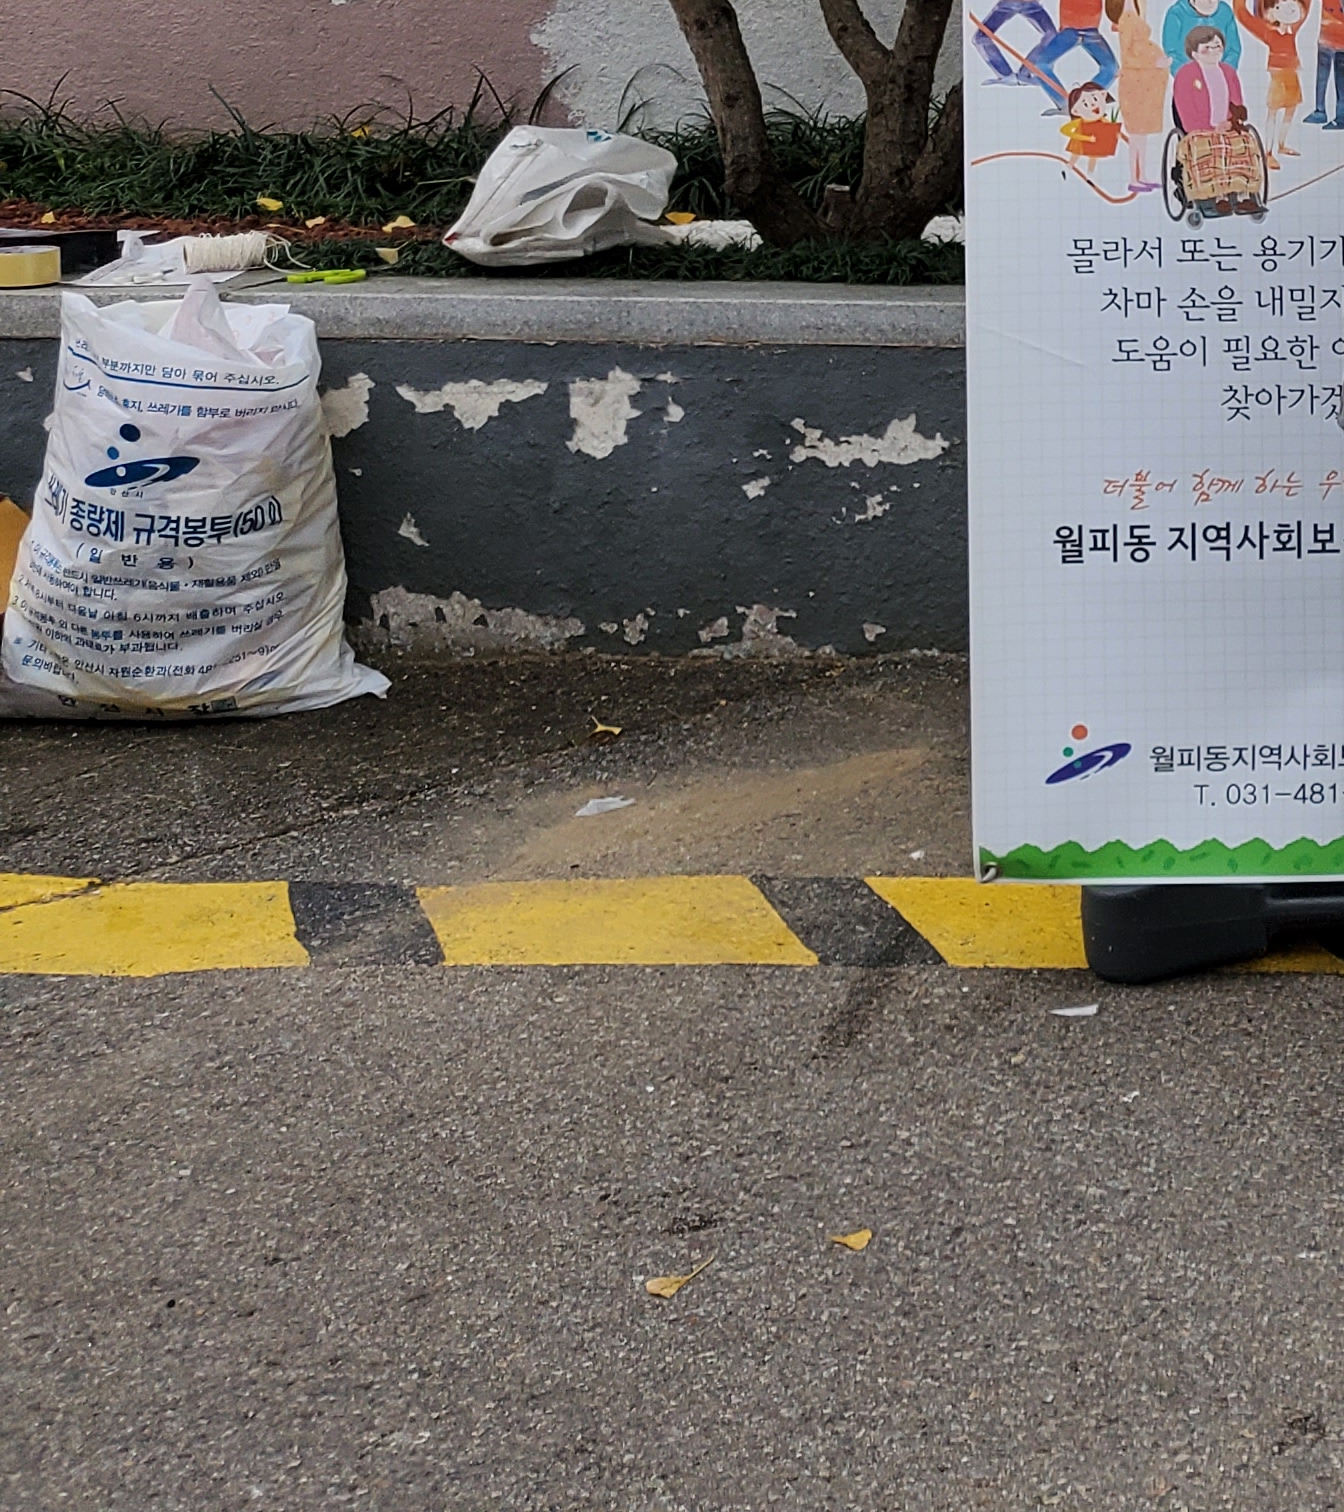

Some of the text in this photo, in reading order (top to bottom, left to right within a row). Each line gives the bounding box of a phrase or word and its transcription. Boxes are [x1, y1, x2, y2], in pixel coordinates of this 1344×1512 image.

[1067, 236, 1164, 274] 몰라서
[1176, 237, 1243, 272] 또는
[1100, 286, 1168, 319] 차마
[1177, 285, 1244, 322] 손을
[1111, 336, 1208, 372] 도움이
[1222, 334, 1320, 370] 필요한
[161, 366, 187, 380] 담아
[146, 401, 192, 417] 쓰레기를
[196, 405, 231, 419] 함부로
[1103, 469, 1179, 510] 더불어
[1190, 467, 1245, 506] 함께
[1254, 469, 1304, 498] 하는
[69, 497, 126, 543] 종량제
[1053, 523, 1158, 564] 월피동
[1193, 783, 1217, 807] T.
